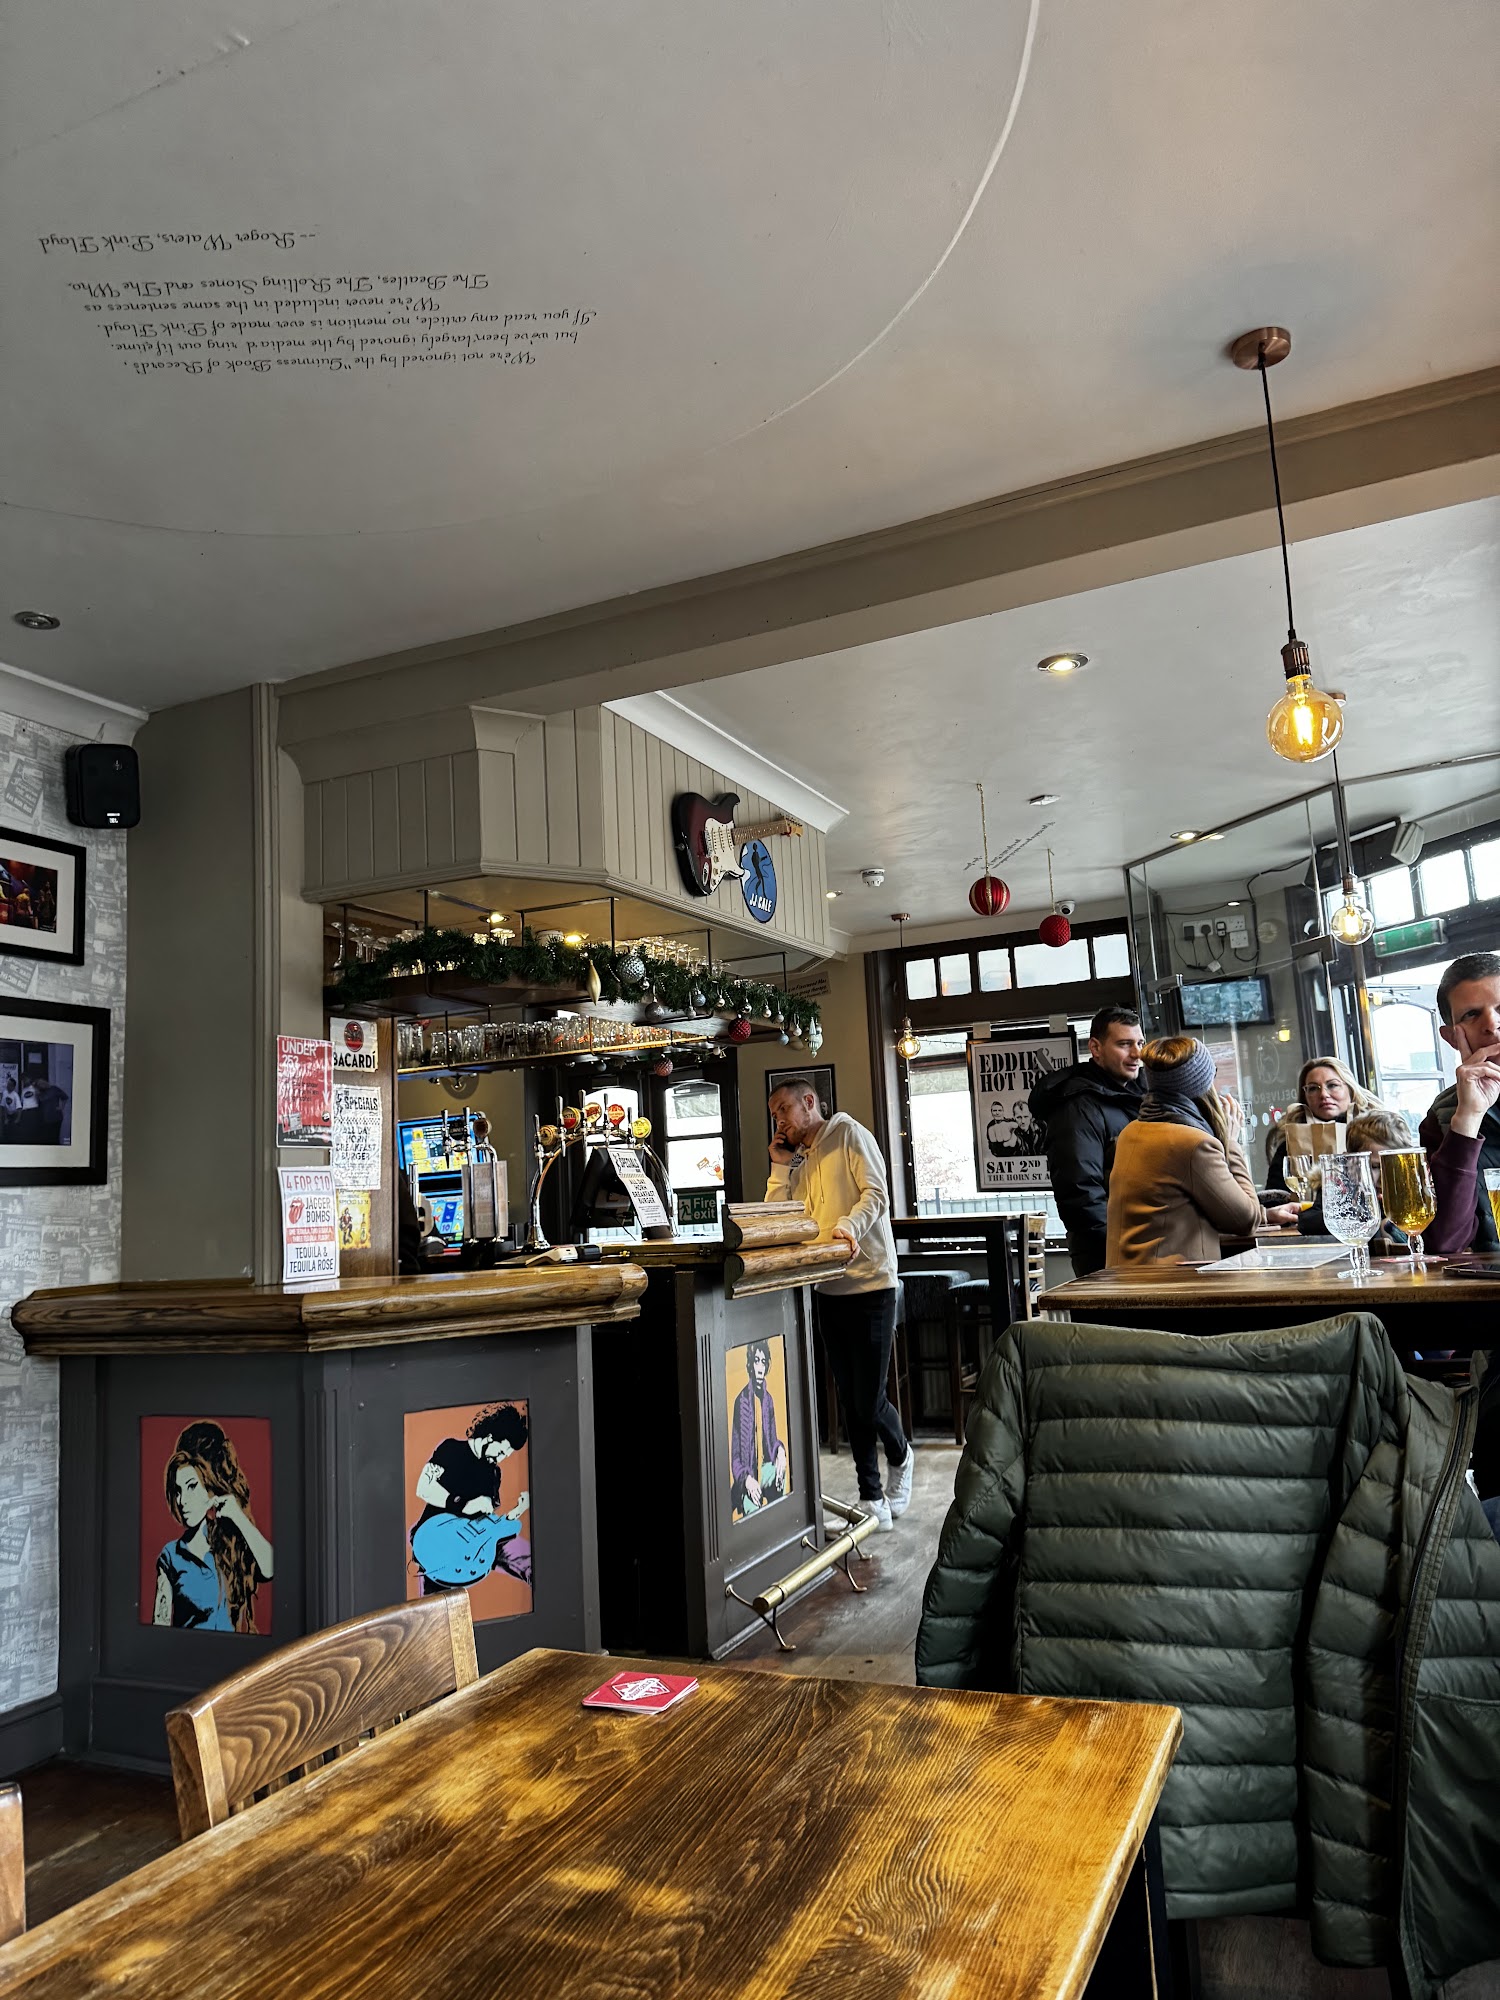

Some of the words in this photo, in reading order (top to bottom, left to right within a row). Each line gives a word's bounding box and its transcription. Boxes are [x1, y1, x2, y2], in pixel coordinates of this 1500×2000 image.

[38, 233, 99, 254] Floyd
[101, 235, 153, 252] Pink
[157, 233, 232, 251] Waters,
[235, 229, 295, 249] Roger
[122, 281, 162, 297] The
[164, 282, 193, 296] and
[201, 279, 257, 295] Stones
[263, 276, 331, 293] Rolling
[336, 276, 373, 292] The
[378, 275, 447, 291] Beatles,
[453, 274, 488, 289] The
[68, 282, 120, 298] Who.
[107, 302, 177, 312] sentences
[182, 301, 220, 309] same
[225, 300, 248, 315] the
[253, 300, 269, 311] in
[274, 298, 339, 314] included
[345, 297, 383, 306] never
[387, 297, 440, 312] We're
[392, 317, 410, 325] no
[471, 313, 498, 322] any
[504, 313, 537, 327] read
[543, 309, 568, 319] you
[572, 309, 596, 325] If
[97, 322, 157, 338] Floyd.
[160, 322, 207, 337] Pink
[211, 320, 225, 336] of
[230, 321, 270, 335] made
[276, 320, 304, 328] ever
[327, 318, 386, 329] mention
[416, 316, 466, 330] article,
[336, 336, 354, 351] by
[360, 334, 415, 351] ignored
[422, 333, 470, 351] largely
[514, 332, 548, 345] we've
[555, 331, 578, 344] but
[260, 340, 305, 353] media
[310, 339, 331, 352] the
[354, 356, 374, 369] the
[381, 354, 396, 368] by
[402, 352, 456, 368] ignored
[462, 352, 483, 362] not
[490, 351, 535, 365] We're
[207, 358, 220, 373] of
[225, 360, 271, 372] Book
[749, 893, 758, 908] JJ
[757, 896, 773, 913] CALE
[281, 1041, 317, 1056] UNDER
[978, 1051, 1039, 1074] EDDIE
[980, 1072, 1016, 1092] HOT
[986, 1160, 1015, 1175] SAT
[286, 1175, 293, 1191] 4
[294, 1175, 312, 1191] FOR
[314, 1175, 330, 1191] £10
[988, 1173, 1005, 1182] THE
[1006, 1172, 1030, 1181] HORN
[1032, 1173, 1043, 1181] ST
[693, 1197, 716, 1209] Fire
[306, 1210, 331, 1223] BOMBS
[693, 1208, 716, 1220] exit
[296, 1247, 322, 1259] TEQUILA
[323, 1246, 328, 1257] &
[290, 1260, 316, 1273] TEQUILA
[317, 1258, 334, 1271] ROSE
